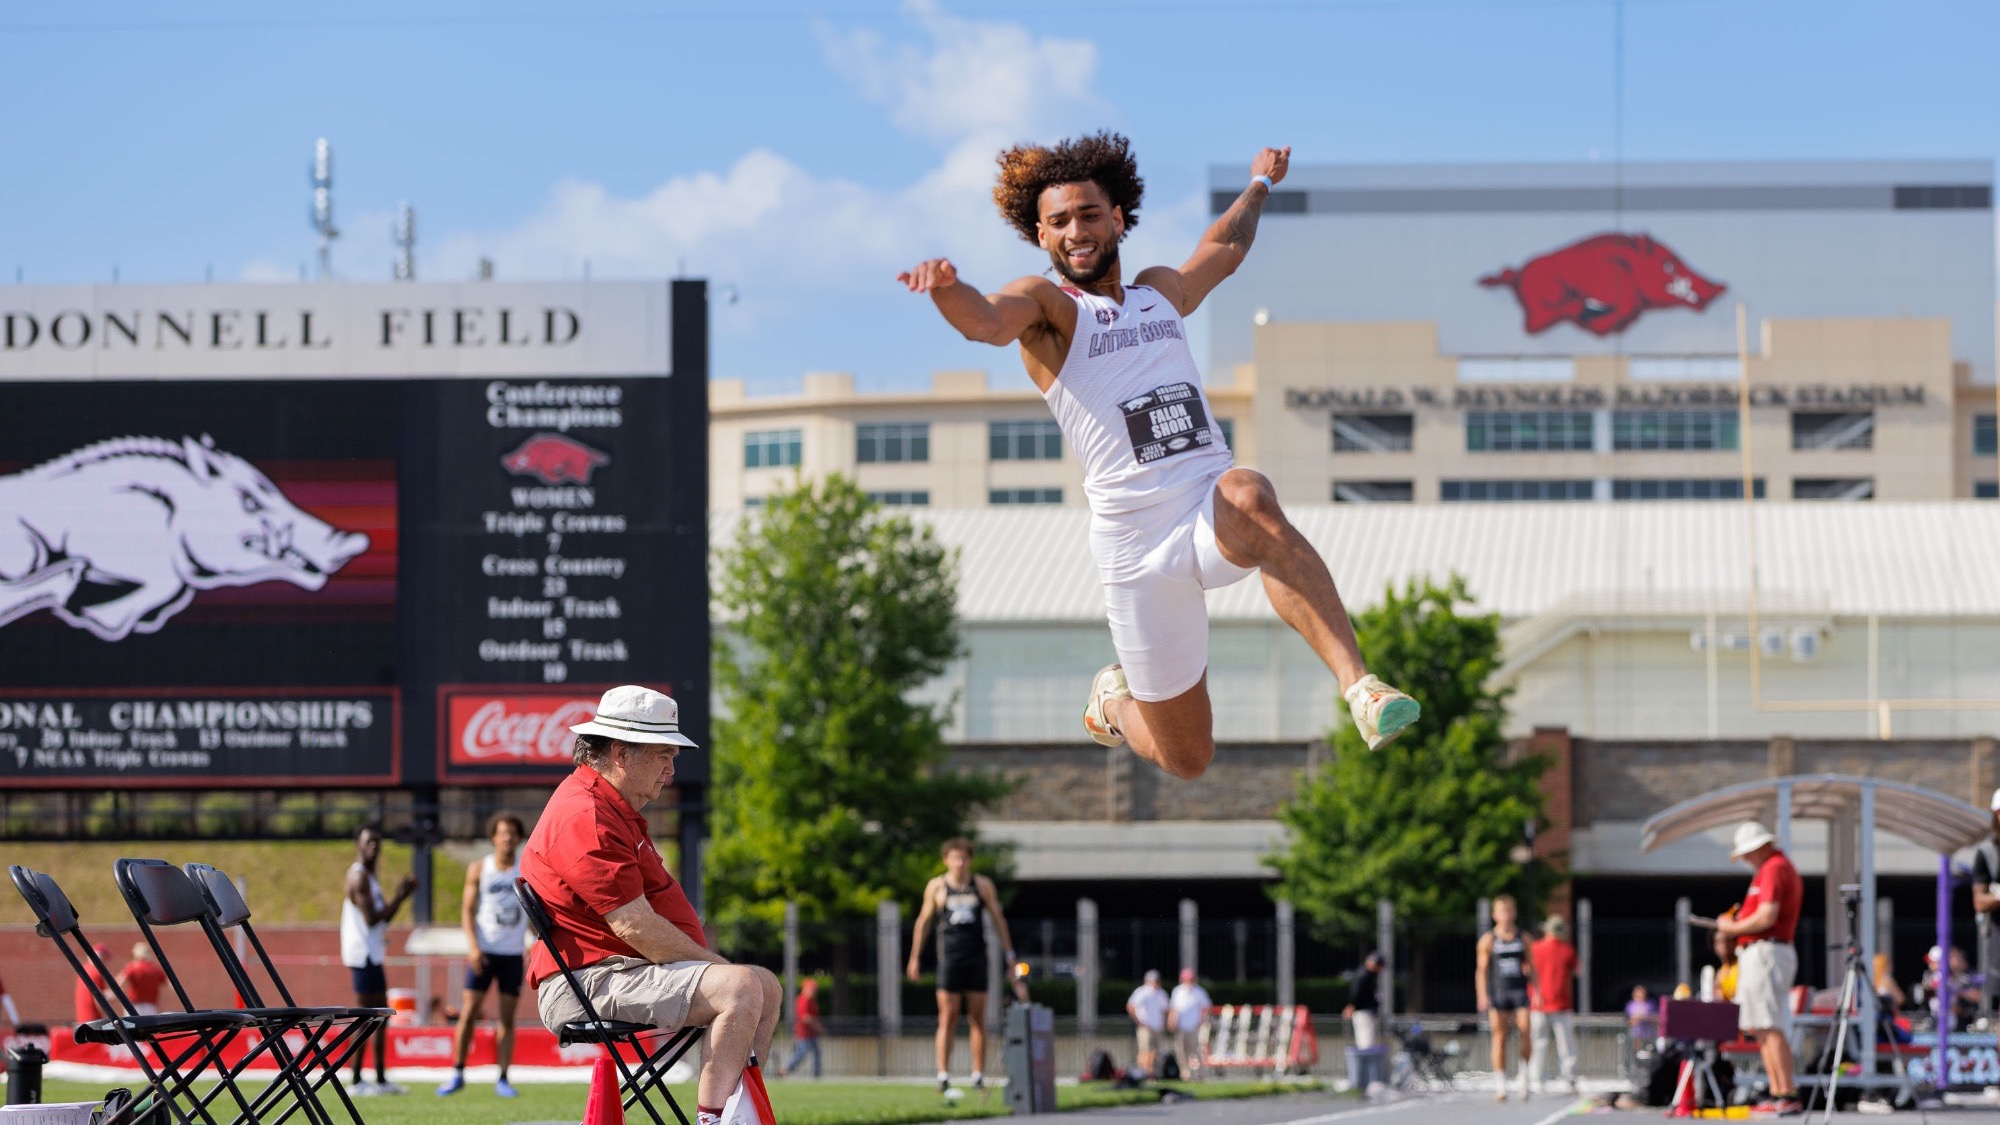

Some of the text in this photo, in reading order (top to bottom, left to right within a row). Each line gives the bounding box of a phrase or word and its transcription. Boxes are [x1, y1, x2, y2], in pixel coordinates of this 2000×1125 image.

[3, 307, 581, 349] DONNELL FIELD
[1088, 320, 1183, 358] LITTLE ROCK
[486, 381, 623, 405] Conference
[1155, 383, 1189, 396] ARKANSAS
[1158, 389, 1192, 403] TWILIGHT
[1285, 386, 1402, 410] DONALD
[1453, 385, 1605, 409] REYNOLDS
[1615, 384, 1788, 408] RAZORBACK
[1795, 383, 1925, 406] STADIUM
[487, 403, 623, 432] Champions
[1149, 403, 1188, 425] FALON
[1151, 415, 1194, 439] SHORT
[511, 486, 595, 509] WOMEN
[482, 510, 628, 537] Triple Crowns
[546, 531, 563, 554] 7
[481, 553, 628, 580] Cross Country
[487, 595, 622, 619] Indoor Track
[478, 638, 629, 662] Outdoor Track
[109, 700, 373, 731] CHAMPIONSHIPS
[68, 729, 124, 750] Indoor
[129, 729, 178, 749] Track
[223, 729, 292, 749] Outdoor
[298, 729, 348, 749] Track
[33, 748, 86, 768] NCAA
[93, 748, 144, 771] Triple
[148, 749, 211, 768] Crowns
